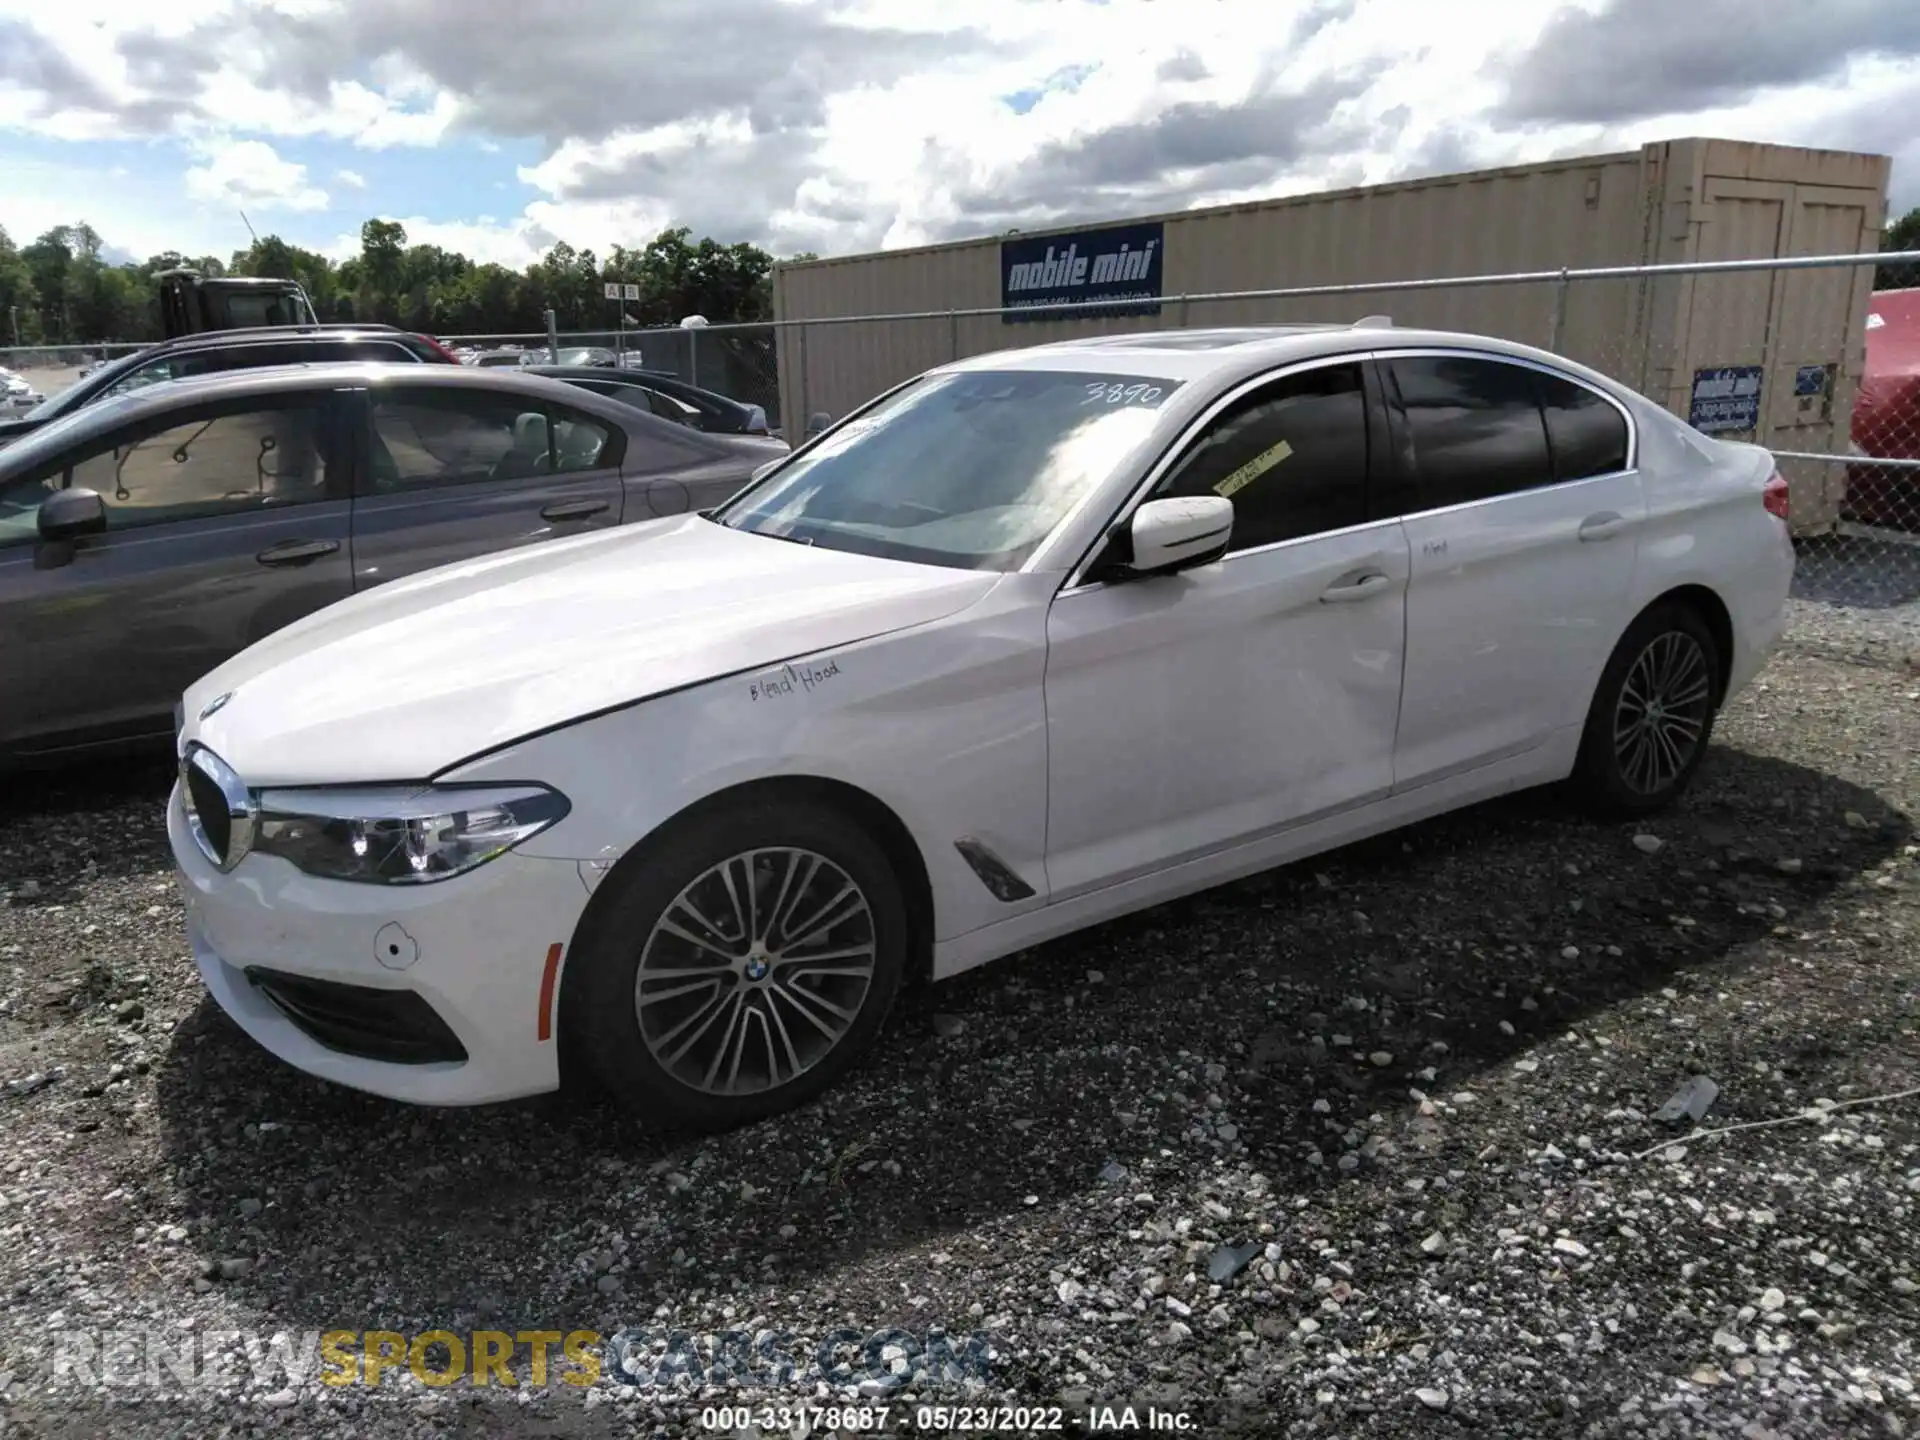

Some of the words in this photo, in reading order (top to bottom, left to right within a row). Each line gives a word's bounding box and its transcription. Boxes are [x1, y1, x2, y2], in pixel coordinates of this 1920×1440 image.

[1008, 243, 1088, 291] mobile
[1090, 240, 1155, 284] mini
[607, 285, 617, 297] A
[1079, 382, 1162, 405] 3890
[750, 676, 794, 702] Blend
[800, 660, 841, 693] Hood
